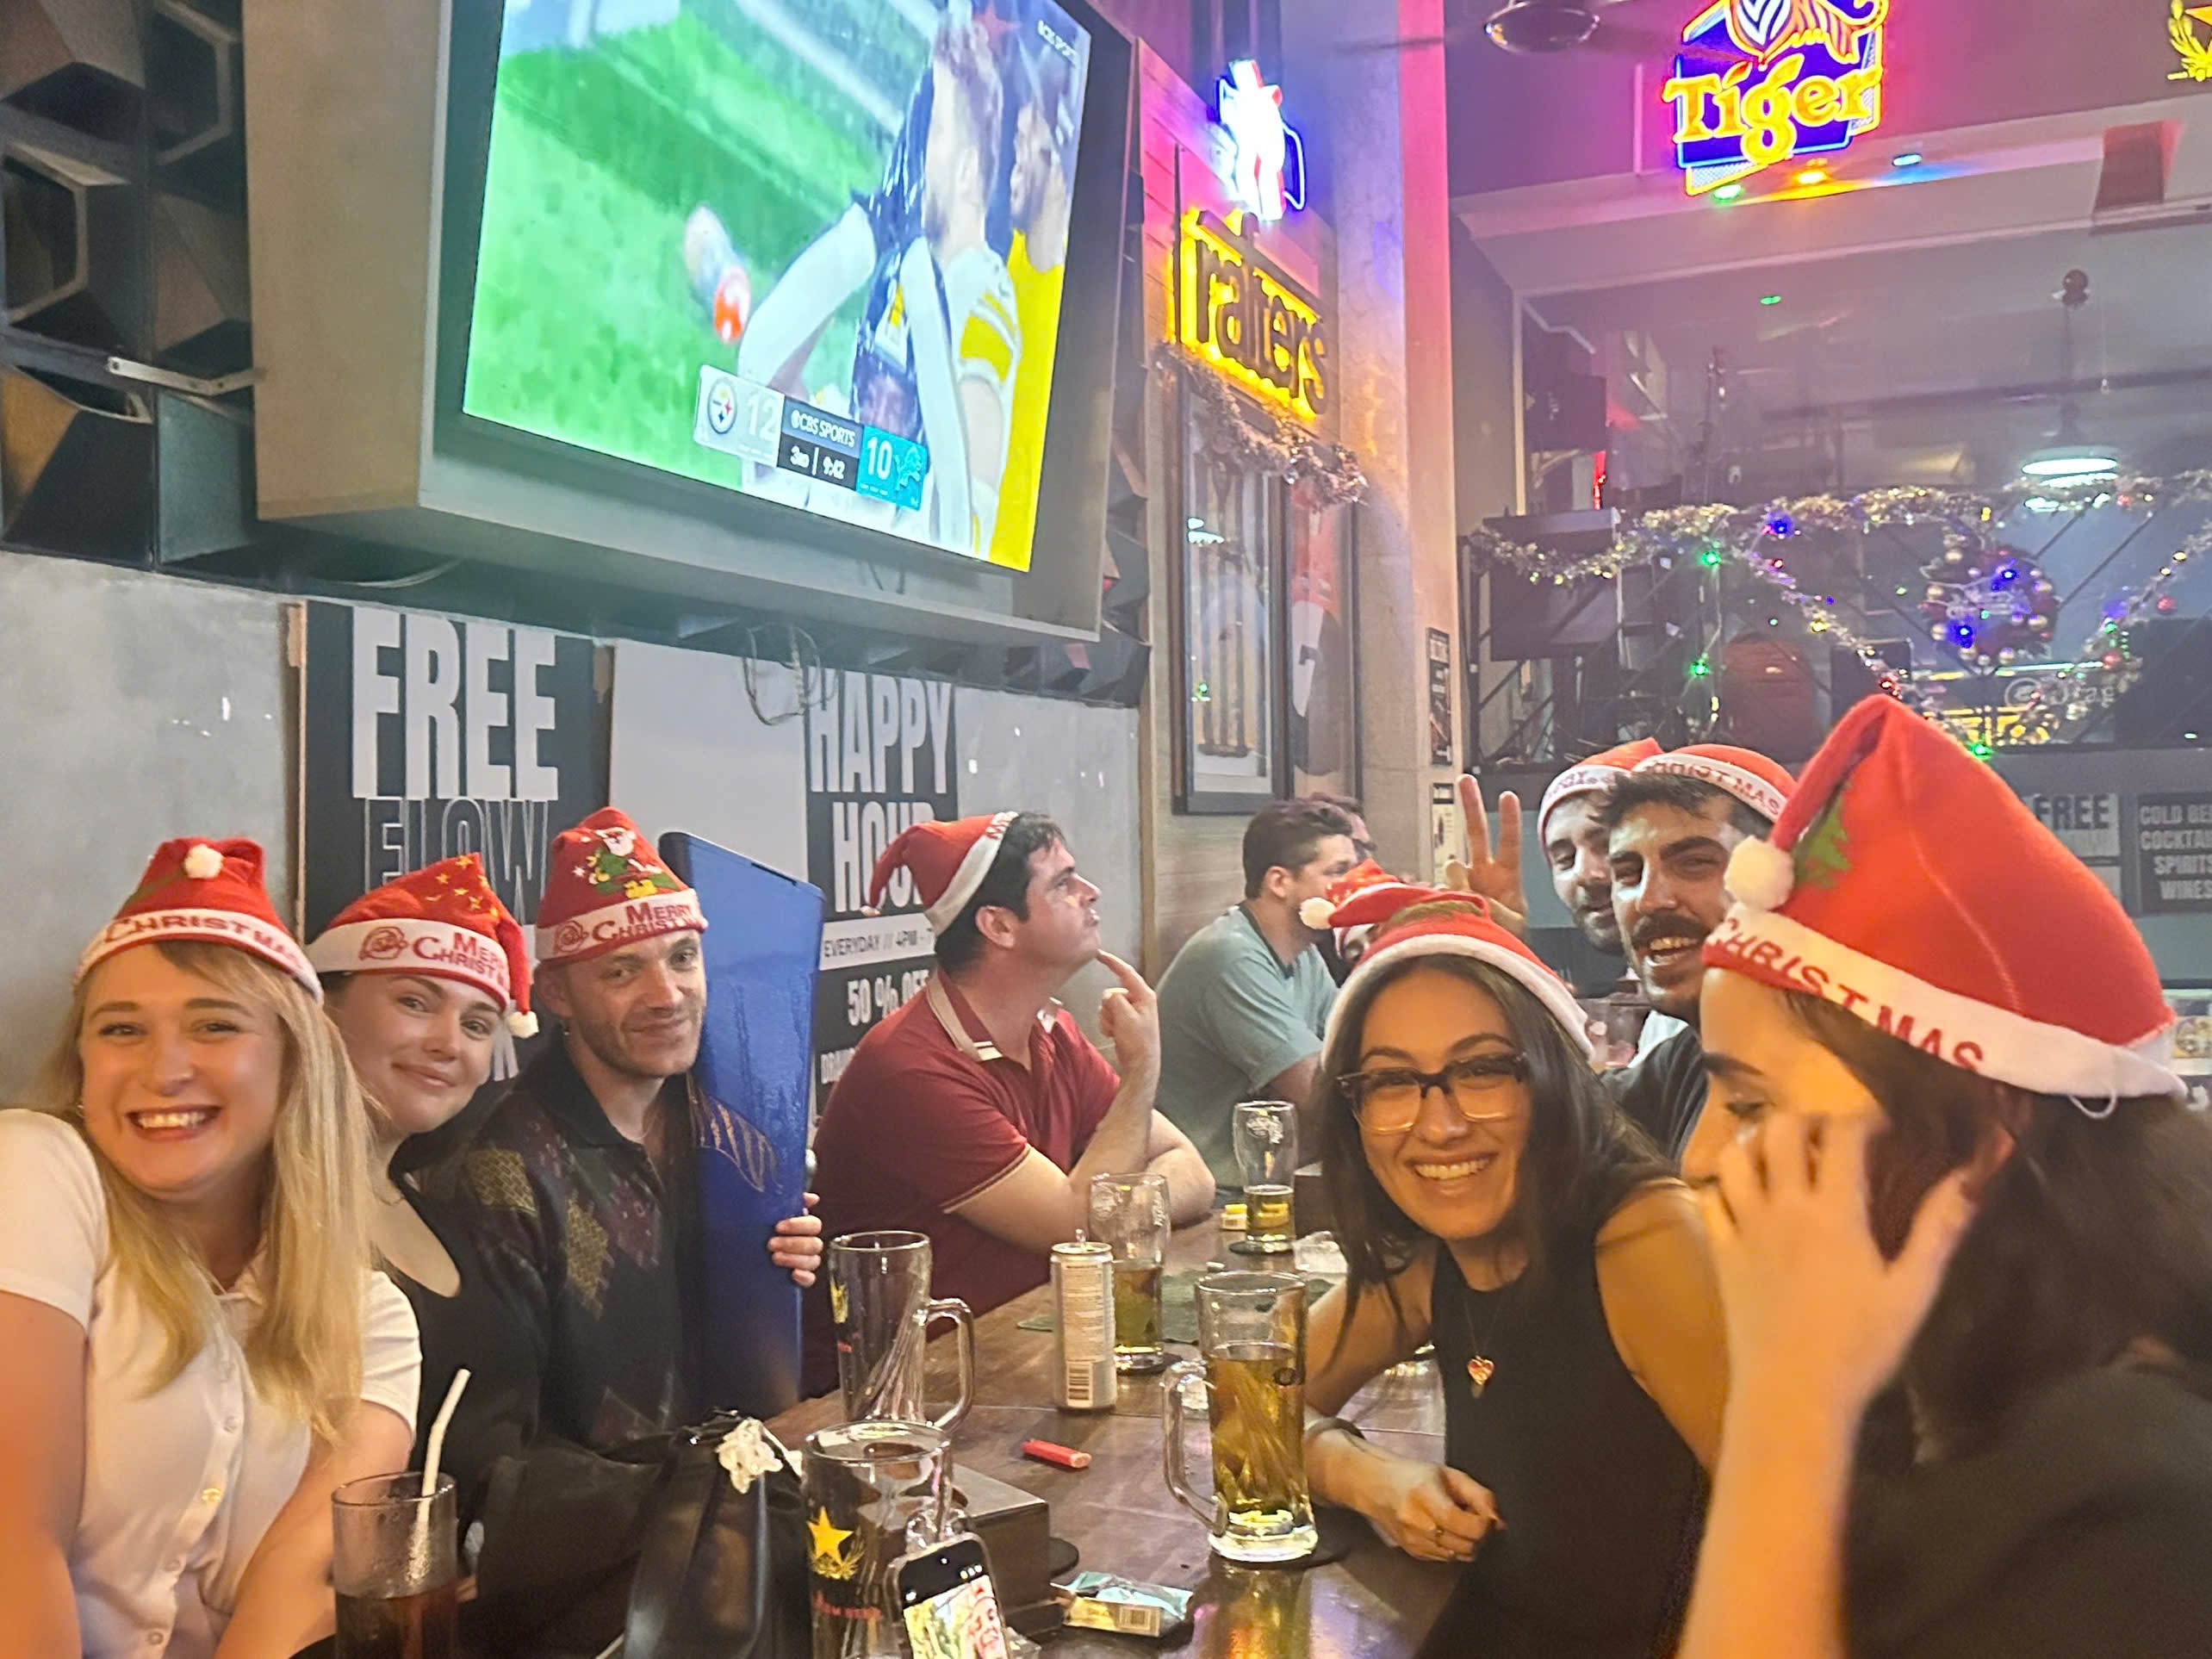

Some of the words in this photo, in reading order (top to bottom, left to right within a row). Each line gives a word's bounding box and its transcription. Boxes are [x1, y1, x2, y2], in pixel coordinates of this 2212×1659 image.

[1663, 53, 1882, 165] Tiger
[746, 390, 776, 442] 12
[799, 413, 819, 435] CBS
[819, 419, 855, 448] SPORTS
[867, 436, 893, 480] 10
[352, 606, 559, 801] FREE
[807, 666, 952, 794] HAPPY
[2033, 794, 2110, 830] FREE
[2140, 805, 2184, 825] COLD
[832, 800, 935, 912] HOU
[824, 935, 879, 958] EVERYDAY
[848, 979, 872, 1026] 50
[875, 974, 899, 1019] %
